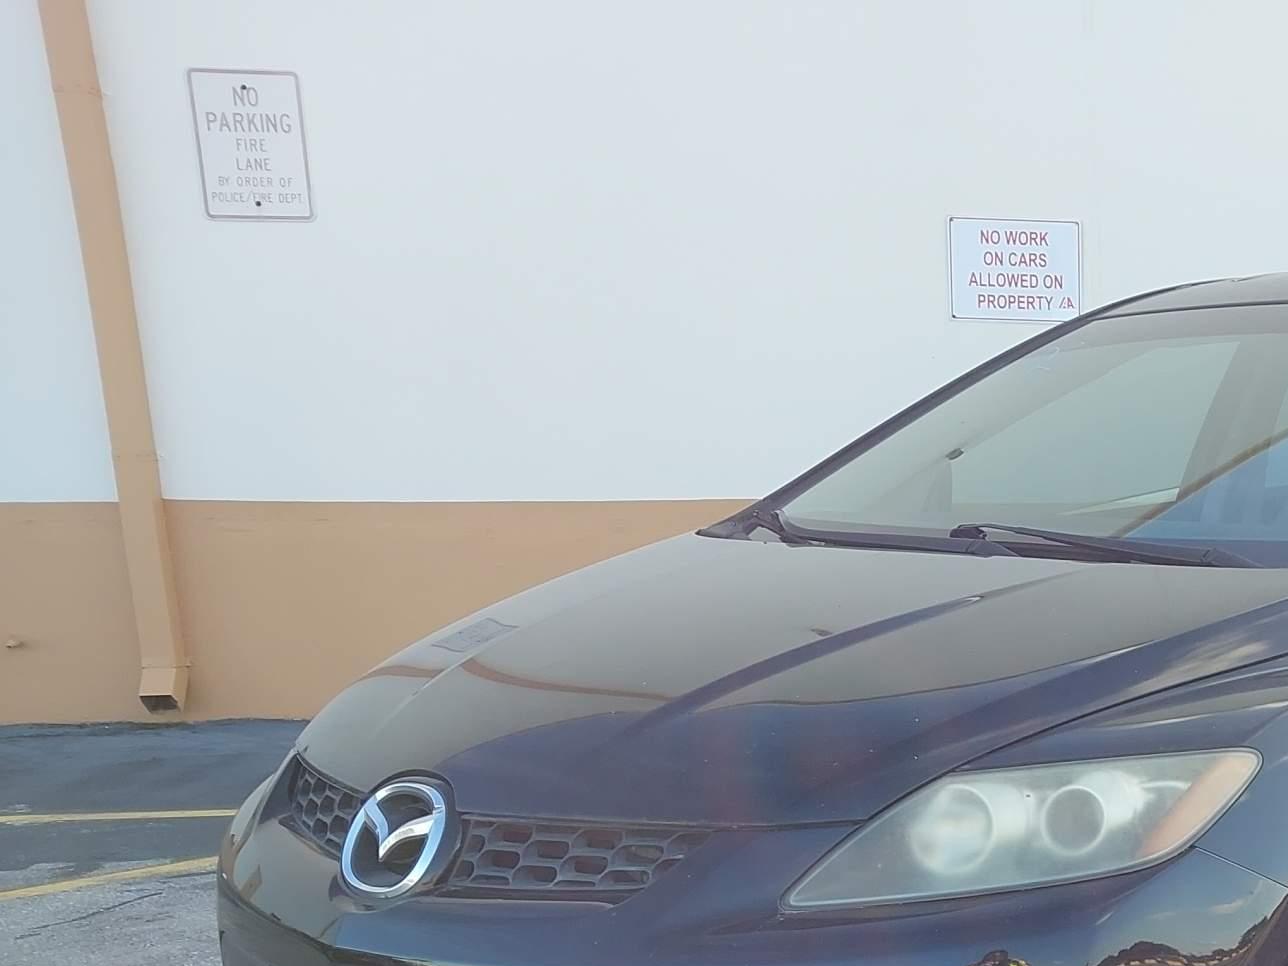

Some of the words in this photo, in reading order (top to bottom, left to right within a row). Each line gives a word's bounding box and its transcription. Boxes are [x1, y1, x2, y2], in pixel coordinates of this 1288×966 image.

[232, 86, 259, 107] NO
[205, 112, 292, 133] PARKING
[236, 138, 268, 153] FIRE
[236, 158, 272, 171] LANE
[218, 176, 231, 187] BY
[236, 176, 273, 188] ORDER
[279, 177, 293, 188] OF
[980, 230, 1001, 245] NO
[1004, 231, 1049, 246] WORK
[983, 251, 1004, 266] ON
[1008, 252, 1047, 267] CARS
[968, 272, 1039, 288] ALLOWED
[1043, 274, 1063, 289] ON
[977, 294, 1053, 310] PROPERTY
